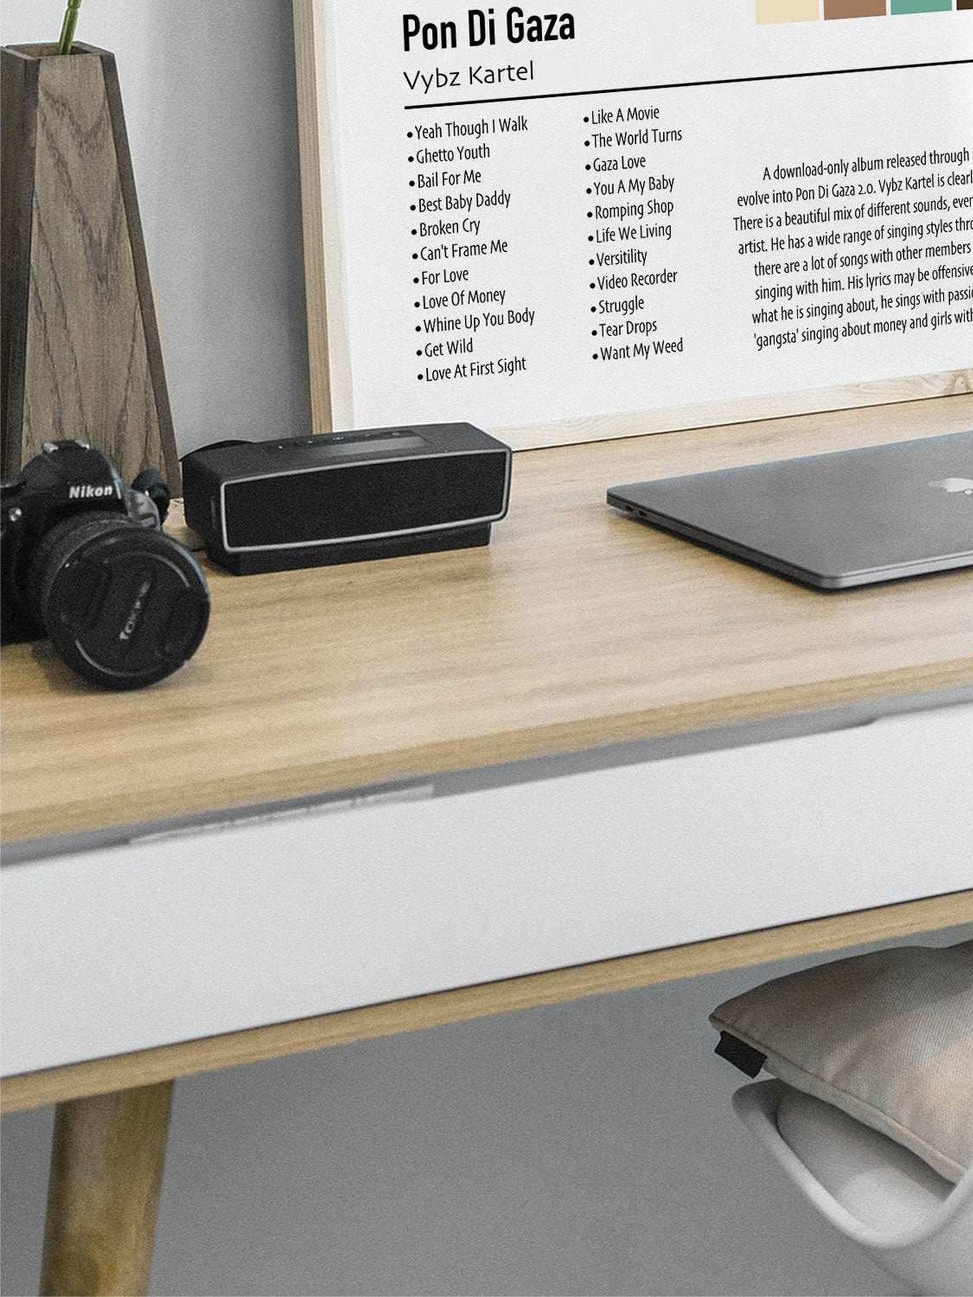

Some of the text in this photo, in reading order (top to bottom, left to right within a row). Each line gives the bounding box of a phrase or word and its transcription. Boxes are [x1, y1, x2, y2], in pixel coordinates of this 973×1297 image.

[402, 6, 575, 52] Pon Di Gaza
[403, 59, 533, 94] Vybz Kartel
[591, 105, 659, 124] Like A Movie
[414, 115, 528, 139] Yeah Though I Walk
[591, 128, 682, 148] The World Turns
[416, 142, 490, 164] Ghetto Youth
[592, 155, 646, 172] Gaza Love
[762, 166, 771, 180] A
[773, 158, 849, 180] download-only
[851, 156, 883, 172] album
[886, 150, 926, 169] released
[928, 147, 969, 166] through
[417, 169, 481, 188] Bail For Me
[593, 174, 674, 195] You A My Baby
[737, 190, 769, 206] evolve
[772, 189, 793, 203] into
[795, 187, 815, 201] Pon
[818, 184, 828, 199] Di
[831, 183, 855, 197] Gaza
[857, 183, 876, 195] 2.0.
[878, 177, 902, 196] Vybz
[905, 173, 934, 190] Kartel
[937, 173, 945, 187] is
[418, 189, 510, 212] Best Baby Daddy
[595, 198, 674, 221] Romping Shop
[732, 215, 763, 230] There
[765, 213, 773, 227] is
[775, 215, 781, 227] a
[784, 206, 830, 226] beautiful
[833, 206, 852, 221] mix
[854, 203, 865, 219] of
[867, 200, 911, 217] different
[913, 195, 950, 213] sounds,
[419, 217, 480, 237] Broken Cry
[596, 222, 671, 243] Life We Living
[738, 238, 767, 254] artist.
[770, 237, 785, 251] He
[787, 234, 805, 249] has
[807, 236, 813, 247] a
[815, 230, 840, 246] wide
[843, 229, 872, 245] range
[874, 224, 884, 240] of
[886, 222, 923, 241] singing
[925, 218, 953, 237] styles
[420, 239, 508, 261] Can't Frame Me
[596, 248, 647, 266] Versitility
[596, 268, 678, 290] Video Recorder
[422, 289, 505, 309] Love Of Money
[598, 294, 644, 316] Struggle
[751, 308, 778, 323] what
[780, 305, 793, 320] he
[796, 305, 804, 319] is
[806, 301, 843, 320] singing
[846, 297, 878, 313] about,
[880, 294, 893, 309] he
[895, 293, 920, 310] sings
[922, 288, 945, 304] with
[423, 306, 535, 333] Whine Up You Body
[598, 320, 657, 337] Tear Drops
[753, 327, 798, 351] 'gangsta'
[801, 325, 838, 344] singing
[841, 321, 871, 337] about
[873, 319, 907, 333] money
[909, 312, 928, 329] and
[930, 310, 952, 330] girls
[599, 336, 683, 360] Want My Weed
[425, 356, 526, 382] Love At First Sight
[69, 485, 113, 499] Nikon
